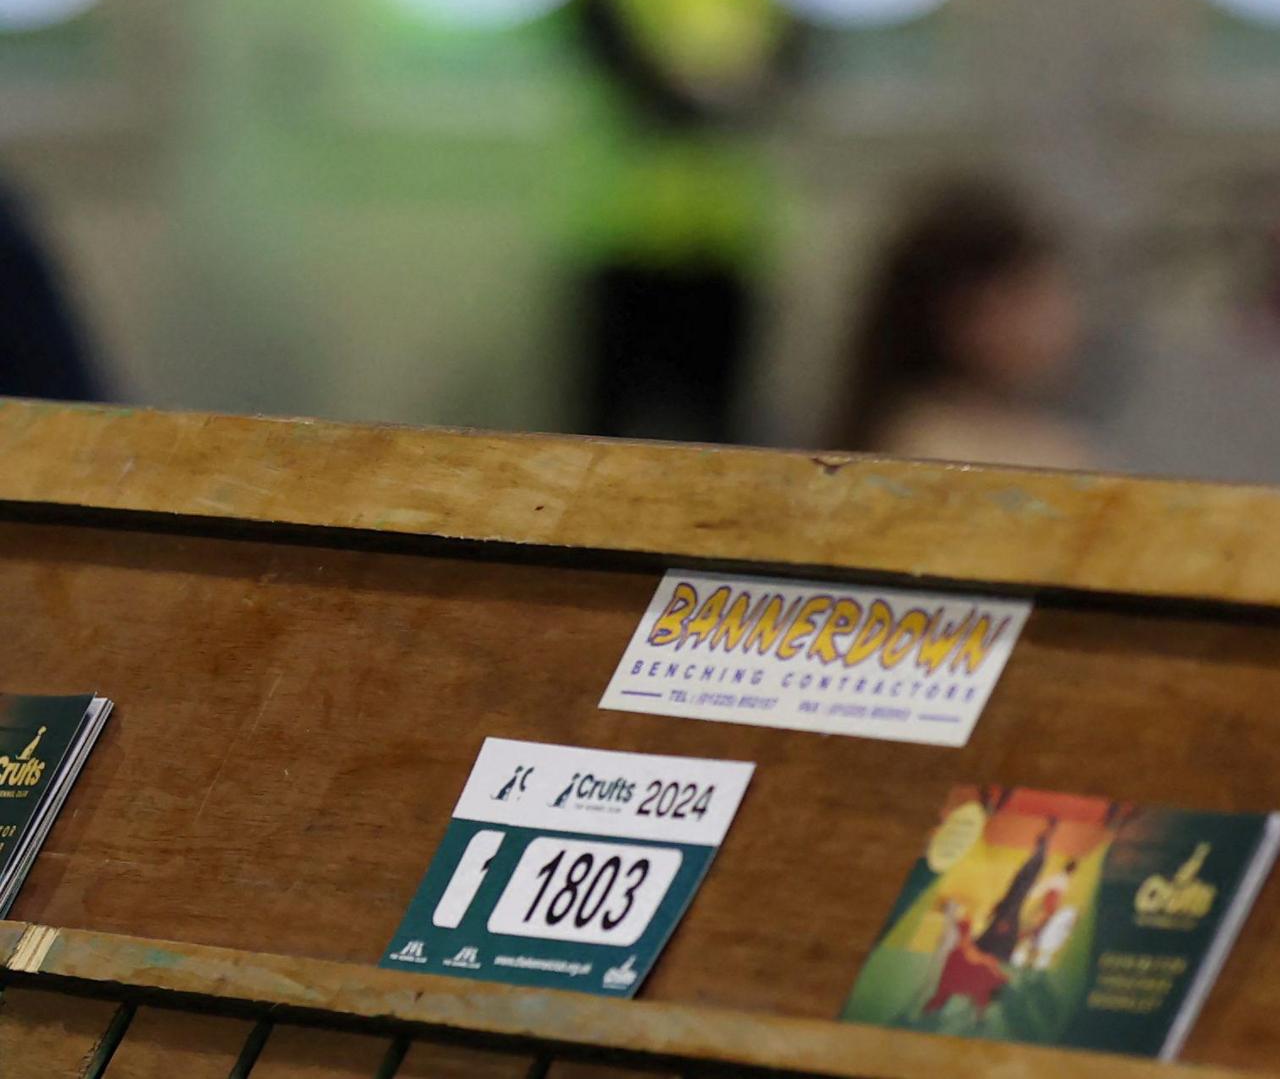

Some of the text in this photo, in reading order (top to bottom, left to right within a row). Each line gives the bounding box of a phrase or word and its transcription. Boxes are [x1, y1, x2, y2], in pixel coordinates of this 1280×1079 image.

[648, 581, 1011, 678] BANNERDOWN
[631, 660, 766, 687] BENCHING
[780, 672, 978, 704] CONTRACTORS
[576, 773, 637, 803] Crufts
[635, 780, 716, 821] 2024
[523, 849, 651, 932] 1803
